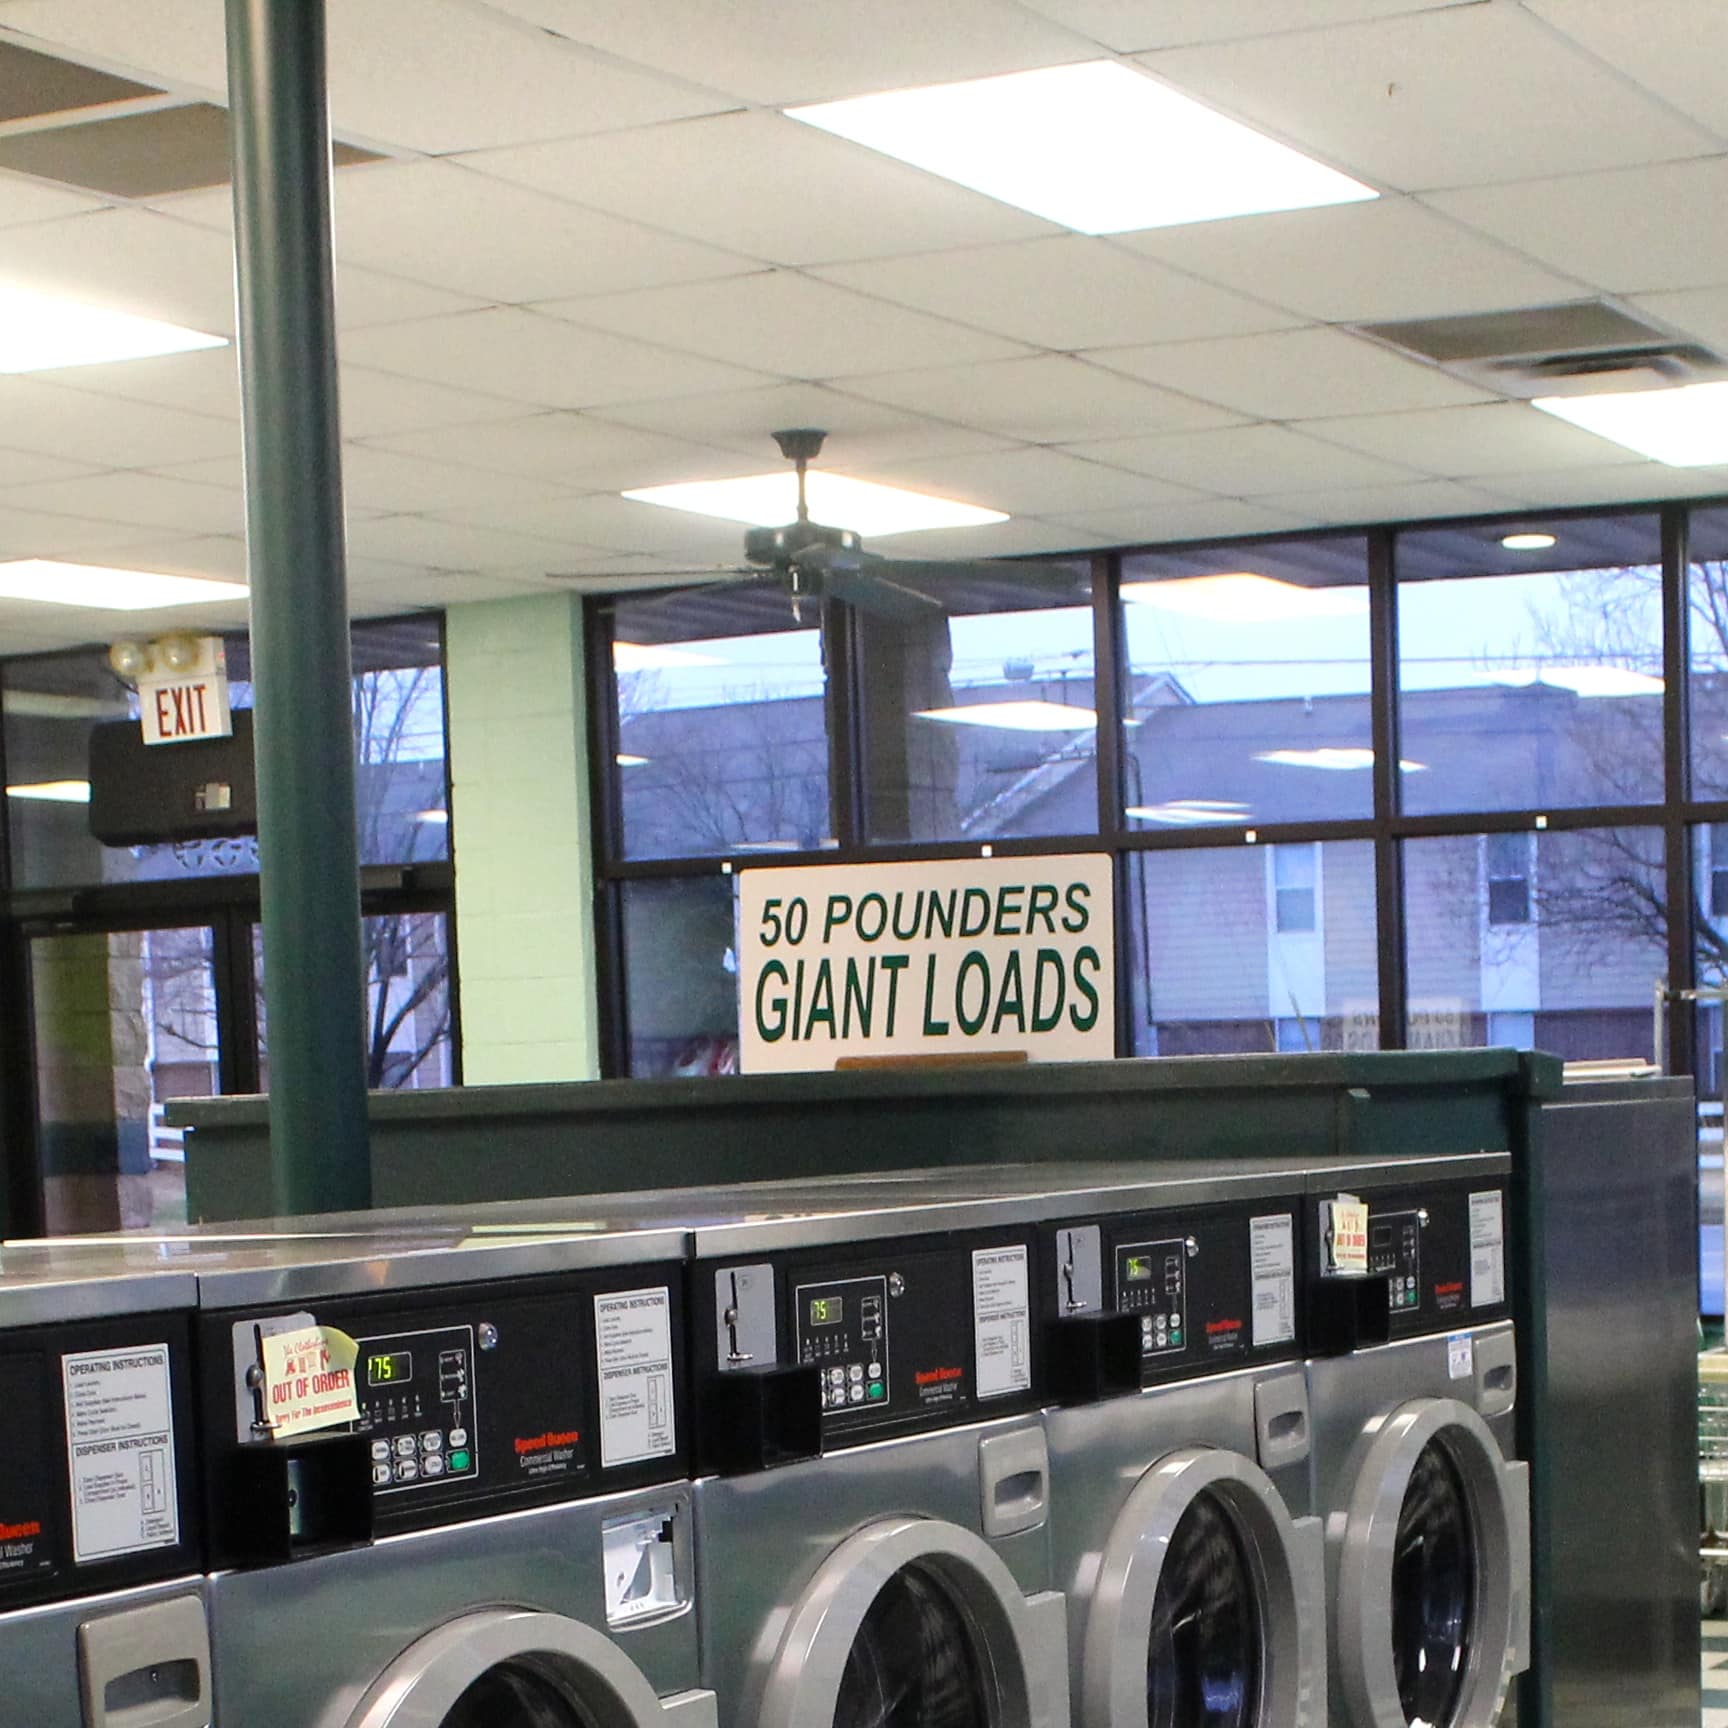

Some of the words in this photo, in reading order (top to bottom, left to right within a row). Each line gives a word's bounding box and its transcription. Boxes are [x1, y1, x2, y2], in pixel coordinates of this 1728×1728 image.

[155, 684, 206, 738] EXIT
[759, 896, 809, 946] 50
[822, 883, 1091, 943] POUNDERS
[755, 954, 910, 1043] GIANT
[922, 945, 1101, 1037] LOADS
[112, 1355, 163, 1371] INSTRUCTIONS
[273, 1381, 292, 1404] OUT
[296, 1377, 309, 1398] OF
[312, 1368, 350, 1394] ORDER
